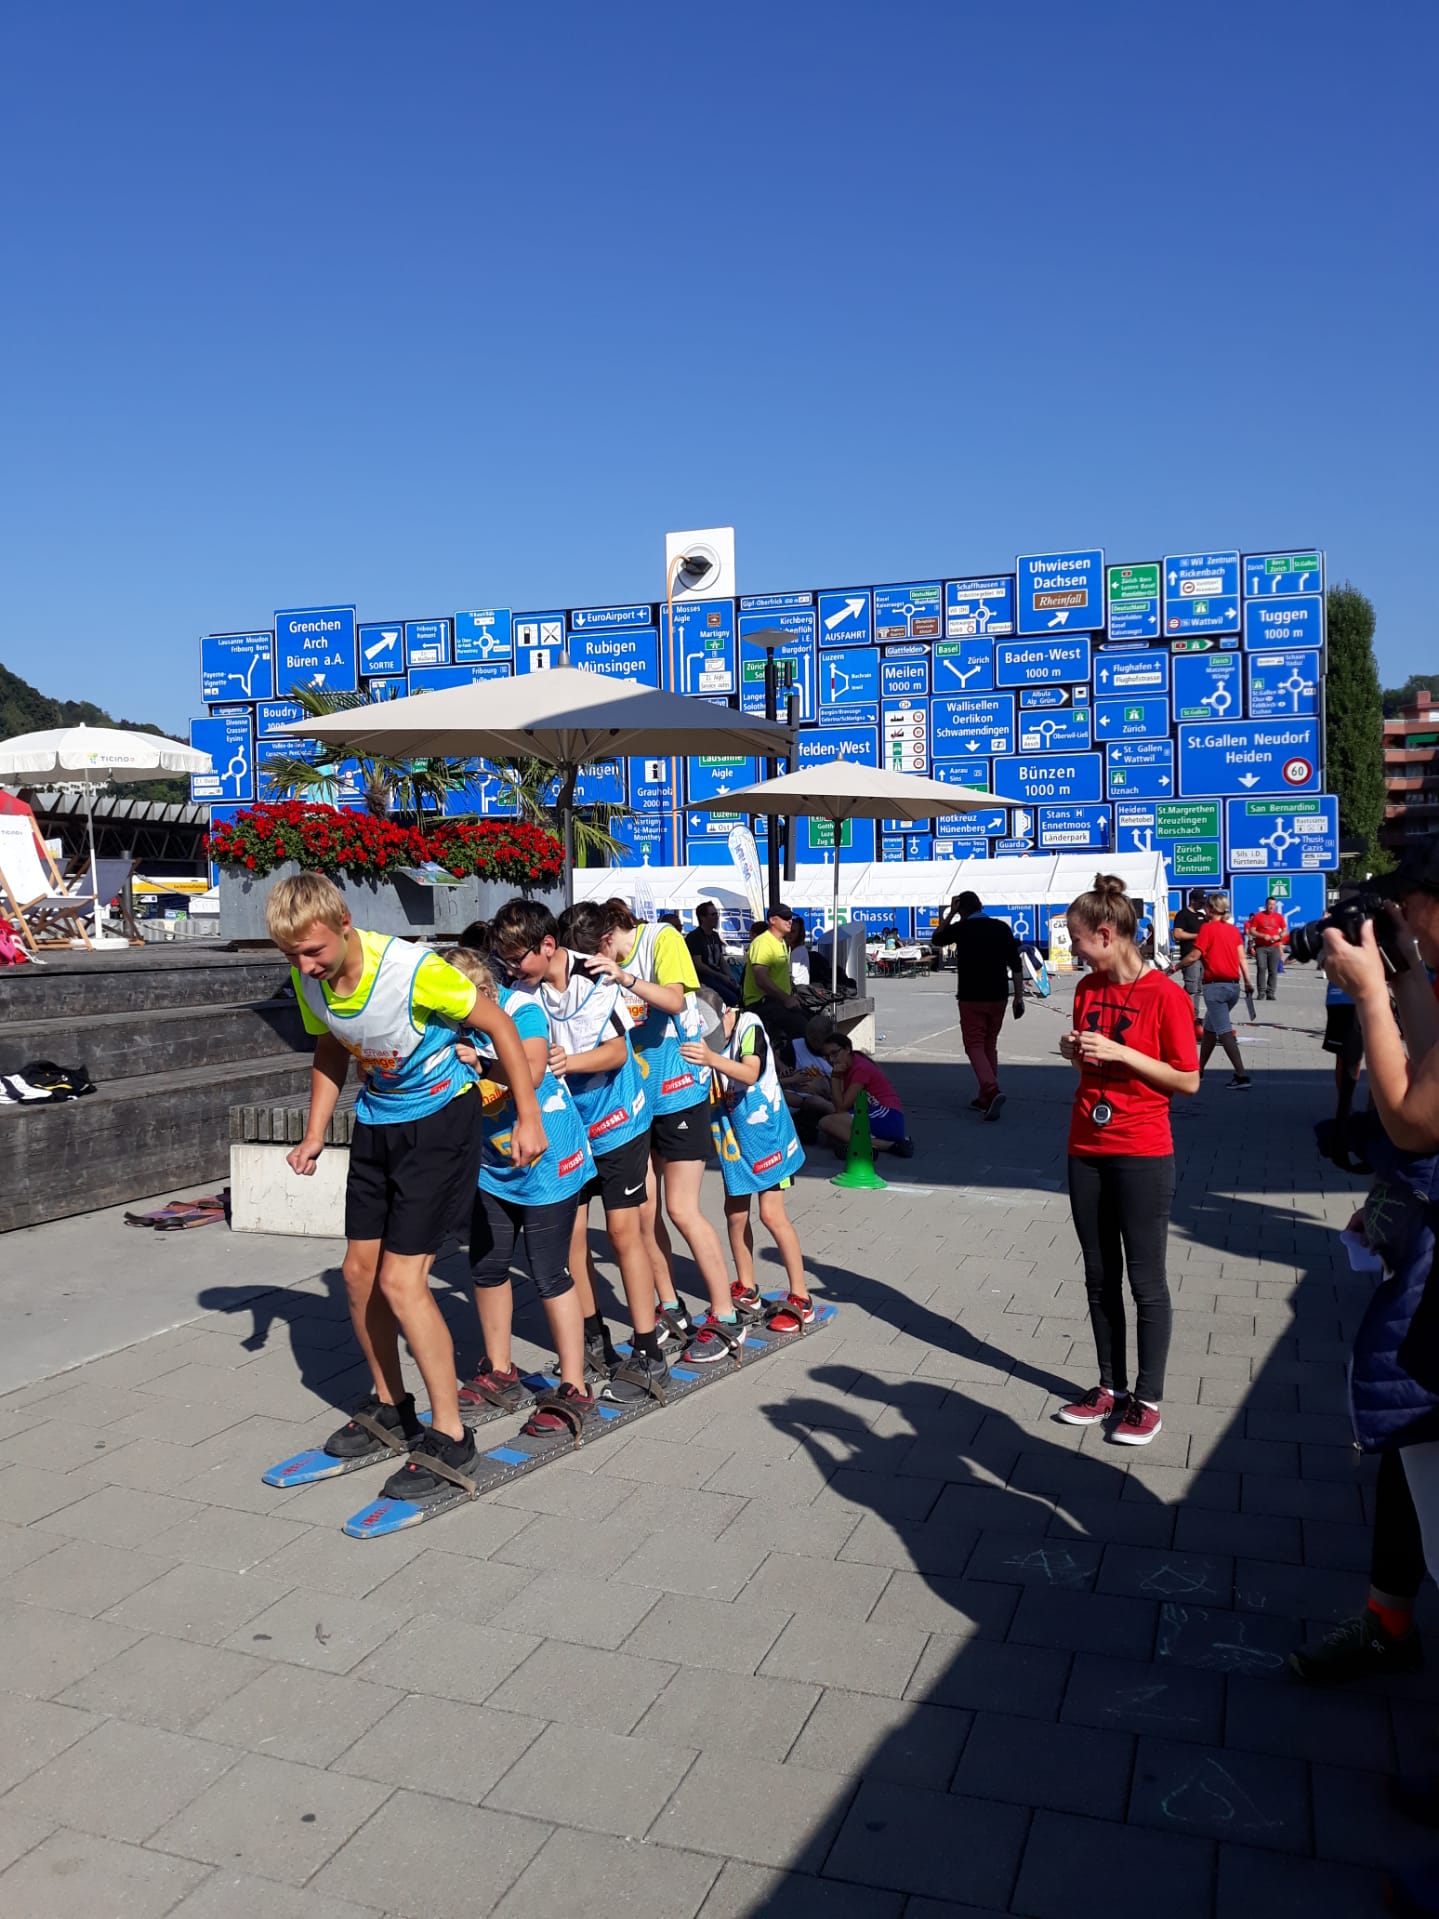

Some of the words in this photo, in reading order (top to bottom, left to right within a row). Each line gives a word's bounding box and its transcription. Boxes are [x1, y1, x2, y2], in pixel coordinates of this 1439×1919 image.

[1029, 558, 1091, 573] Uhwiesen
[1207, 557, 1236, 565] Zentrum
[1180, 568, 1225, 577] Rickenbach
[956, 582, 998, 590] Schaffhausen
[1034, 575, 1087, 589] Dachsen
[1039, 593, 1082, 606] Rheinfall
[676, 605, 701, 613] Mosses
[587, 611, 635, 623] EuroAirport
[673, 614, 691, 623] Aigle
[780, 616, 813, 625] Kirchberg
[1191, 616, 1223, 626] Wattwil
[1259, 609, 1308, 624] Tuggen
[289, 618, 341, 633] Grenchen
[700, 630, 730, 638] Martigny
[825, 630, 866, 641] AUSFAHRT
[1264, 629, 1290, 639] 1000
[1293, 629, 1303, 638] m
[303, 636, 328, 649] Arch
[586, 641, 636, 656] Rubigen
[782, 645, 812, 654] Burgdorf
[887, 645, 923, 655] Glattfelden
[938, 645, 959, 654] Basel
[287, 655, 318, 668] Büren
[324, 653, 345, 666] a.A.
[967, 656, 990, 665] Zürich
[1005, 648, 1081, 664] Baden-West
[369, 661, 394, 670] SORTIE
[577, 660, 646, 675] Münsingen
[1113, 663, 1152, 673] Flughafen
[472, 667, 497, 675] Fribourg
[885, 666, 924, 679] Meilen
[1026, 668, 1049, 678] 1000
[1052, 668, 1061, 677] m
[888, 682, 910, 691] 1000
[913, 682, 922, 690] m
[946, 700, 999, 712] Wallisellen
[263, 706, 297, 719] Boudry
[952, 713, 993, 724] Oerlikon
[936, 725, 1009, 738] Schwamendingen
[1122, 724, 1146, 734] Zürich
[1188, 734, 1247, 749] St.Gallen
[1254, 730, 1311, 745] Neudorf
[798, 741, 871, 756] felden-West
[1137, 744, 1163, 753] Gallen
[1124, 754, 1156, 763] Wattwil
[1225, 751, 1272, 764] Heiden
[712, 768, 734, 780] Aigle
[1019, 765, 1075, 780] Bünzen
[1291, 766, 1304, 777] 60
[1025, 784, 1054, 796] 1000
[1059, 785, 1070, 795] m
[1110, 787, 1139, 795] Uznach
[643, 800, 660, 808] 2000
[1250, 804, 1266, 813] San
[1269, 803, 1316, 812] Bernardino
[1046, 810, 1070, 819] Stans
[1118, 806, 1147, 814] Heiden
[1158, 805, 1215, 814] St.Margrethen
[1120, 816, 1153, 824] Rehetobel
[1158, 816, 1208, 825] Kreuzlingen
[940, 824, 986, 834] Hünenberg
[1042, 821, 1091, 830] Ennetmoos
[1158, 826, 1201, 835] Rorschach
[1044, 833, 1087, 842] Länderpark
[999, 840, 1025, 849] Guarda
[1176, 845, 1202, 853] Zürich
[1233, 857, 1266, 865] Fürstenau
[1176, 864, 1211, 872] Zentrum
